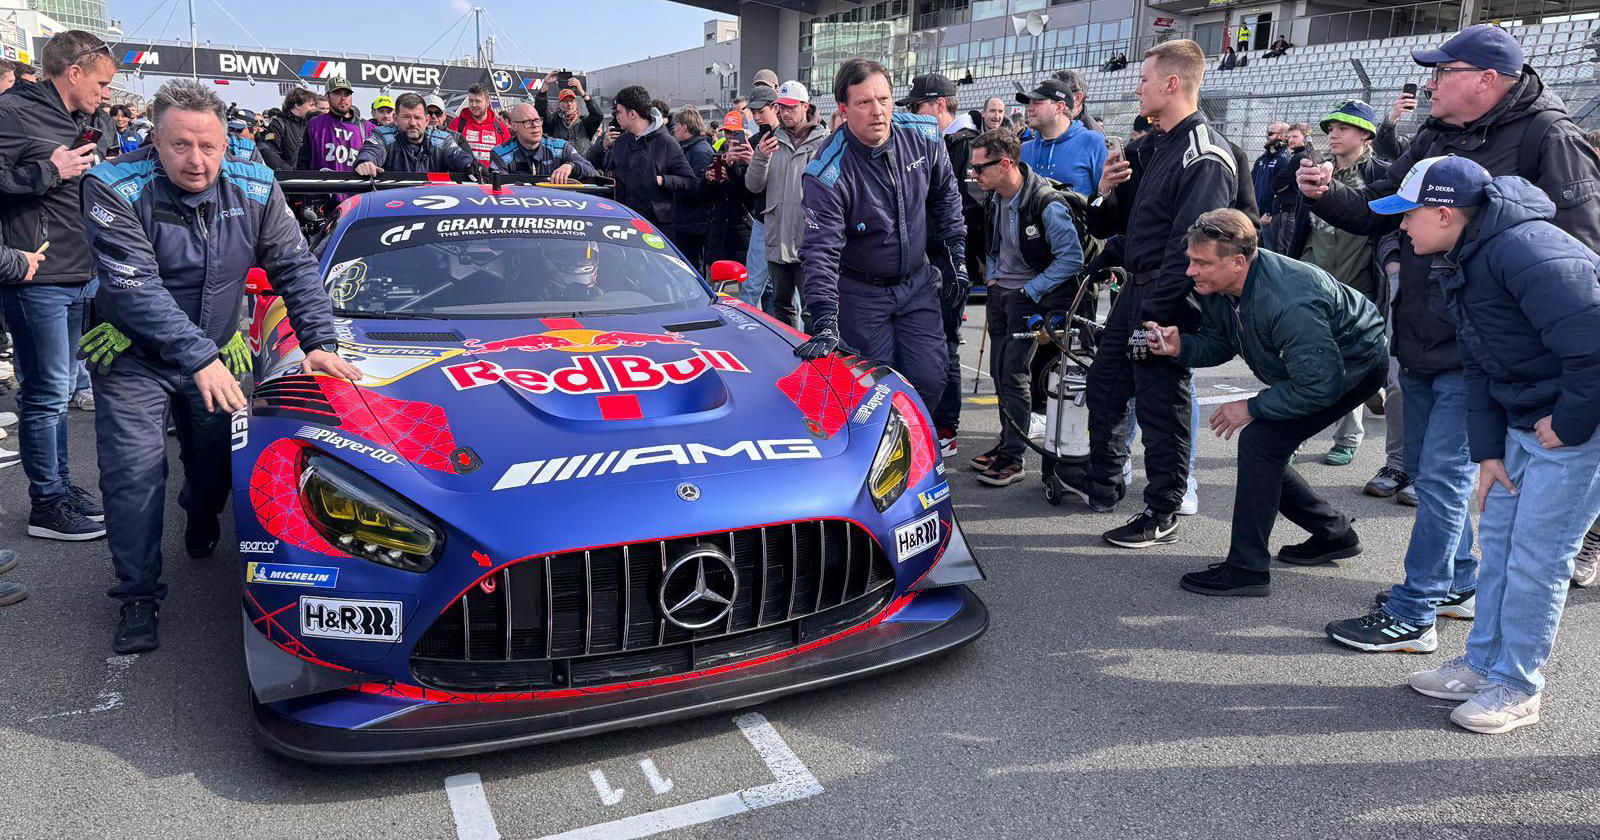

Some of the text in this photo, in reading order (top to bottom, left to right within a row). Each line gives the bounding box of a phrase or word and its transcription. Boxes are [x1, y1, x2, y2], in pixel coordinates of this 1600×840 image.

[219, 53, 280, 75] BMW
[361, 63, 440, 85] POWER
[334, 127, 353, 141] TV
[325, 143, 360, 166] 205
[247, 184, 268, 196] OMP
[1435, 185, 1454, 193] DEKRA
[466, 194, 588, 210] viaplay
[91, 206, 114, 224] OMP
[437, 218, 494, 232] GRAN
[532, 228, 586, 236] SIMULATOR
[331, 261, 368, 302] 3
[440, 348, 752, 395] Red Bull
[231, 406, 249, 452] KEN
[899, 527, 924, 554] H&R
[270, 570, 330, 582] MICHELIN
[304, 603, 361, 634] H&R
